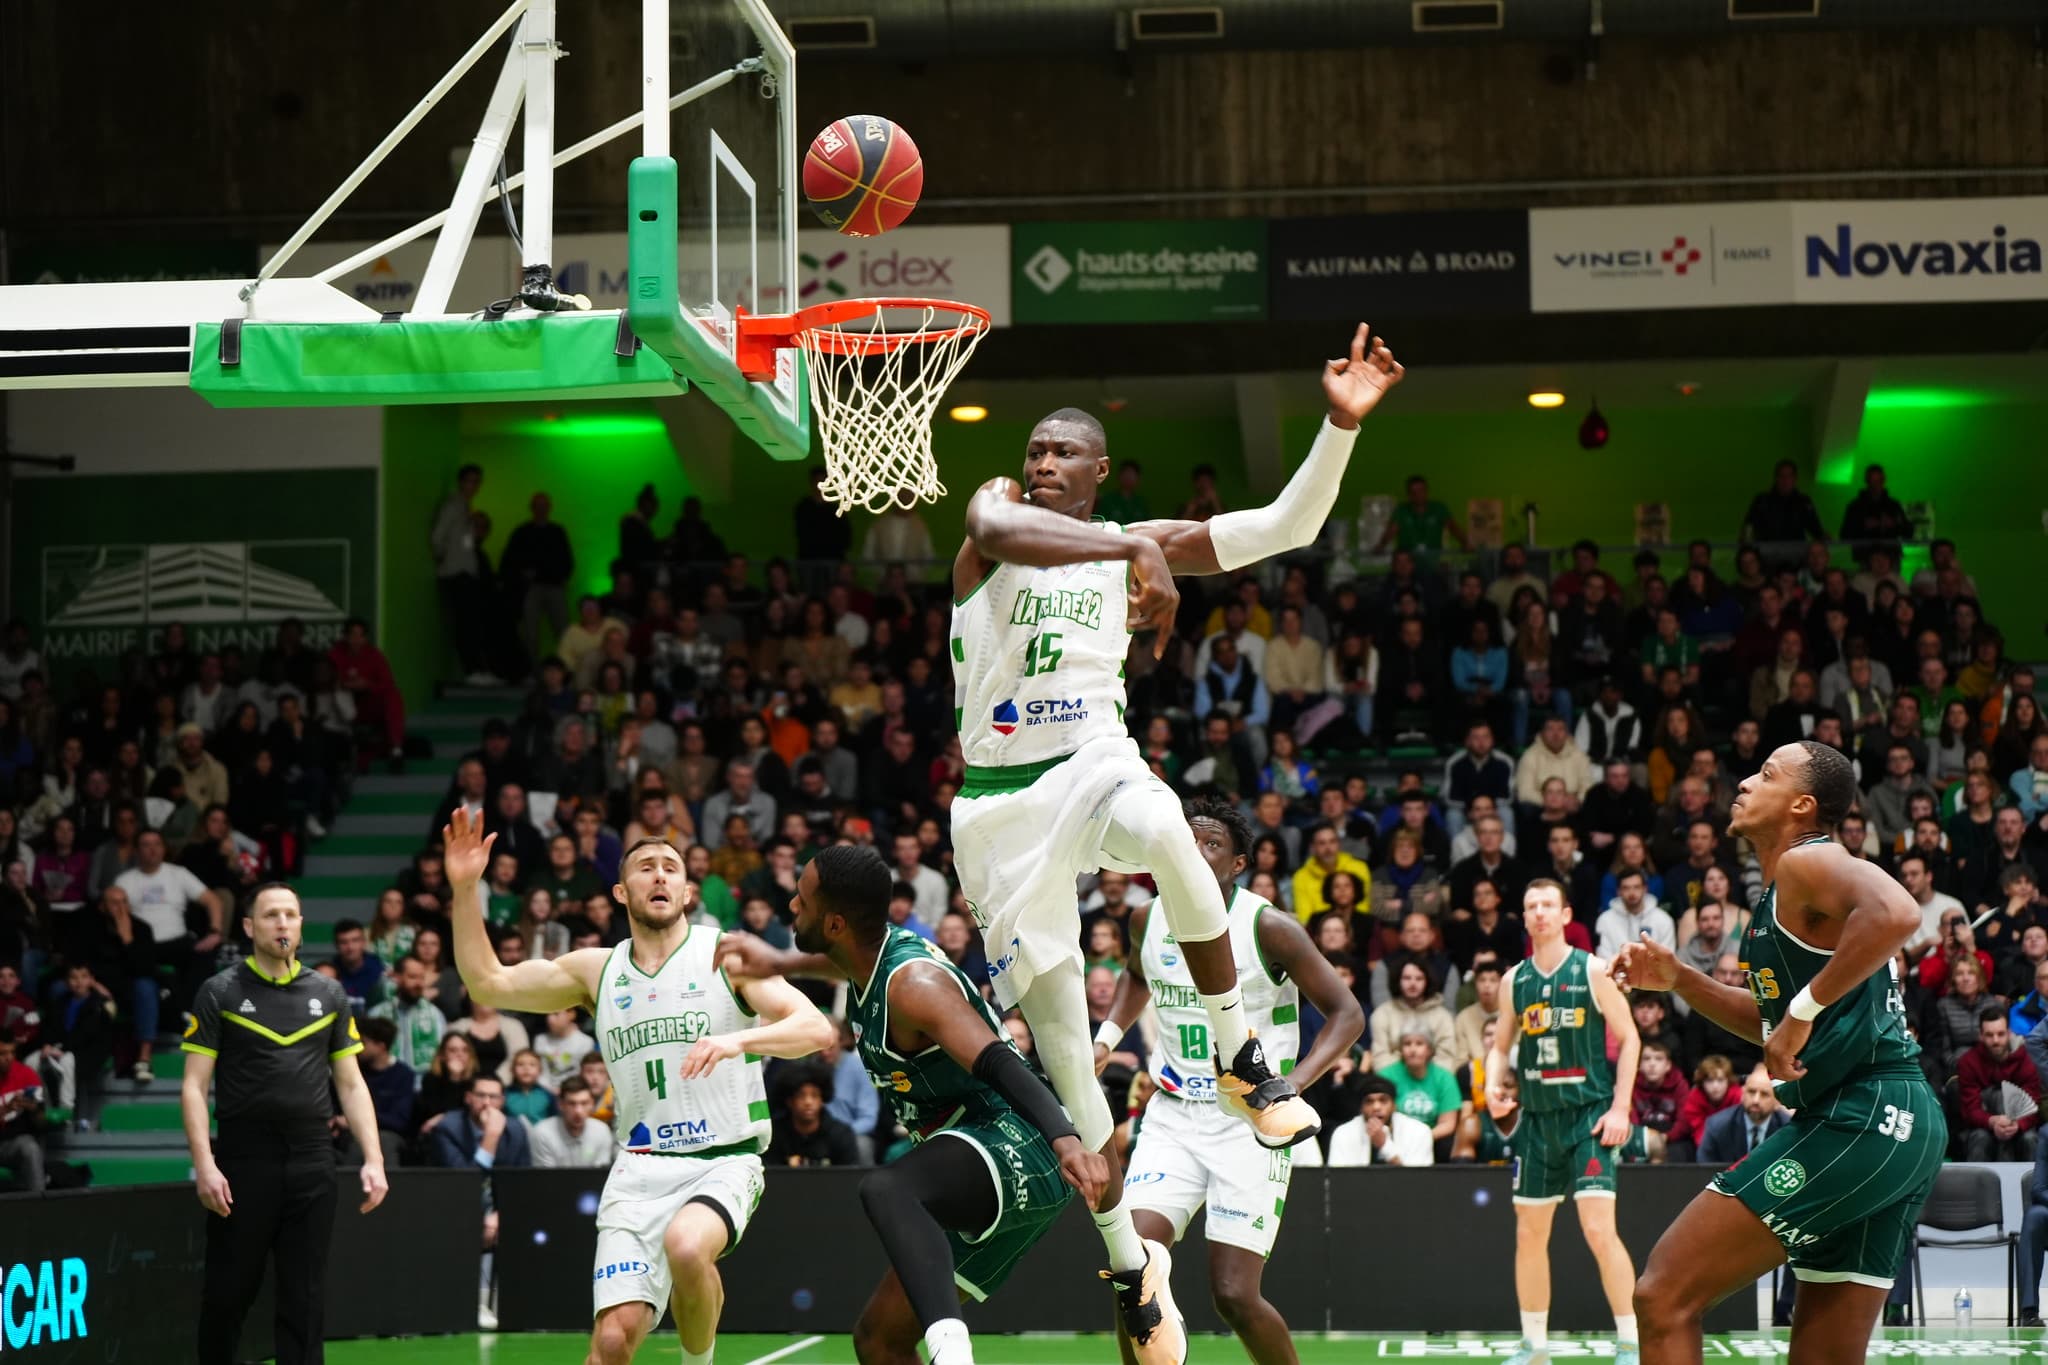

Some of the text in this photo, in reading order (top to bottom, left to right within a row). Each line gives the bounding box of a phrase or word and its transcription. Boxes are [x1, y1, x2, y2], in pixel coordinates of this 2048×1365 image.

[1286, 251, 1516, 278] KAUFMAN BROAD
[1554, 250, 1653, 268] VINCI
[1805, 223, 2043, 278] Novaxia
[860, 248, 953, 288] idex
[1024, 632, 1064, 678] 15
[1026, 697, 1083, 715] GTM
[1176, 1023, 1209, 1060] 19
[1536, 1036, 1560, 1066] 15
[645, 1058, 667, 1100] 4
[1187, 1076, 1217, 1089] GT
[656, 1119, 708, 1139] GTM
[1878, 1104, 1915, 1143] 35
[1771, 1164, 1800, 1189] CSP
[0, 1256, 89, 1351] CAR
